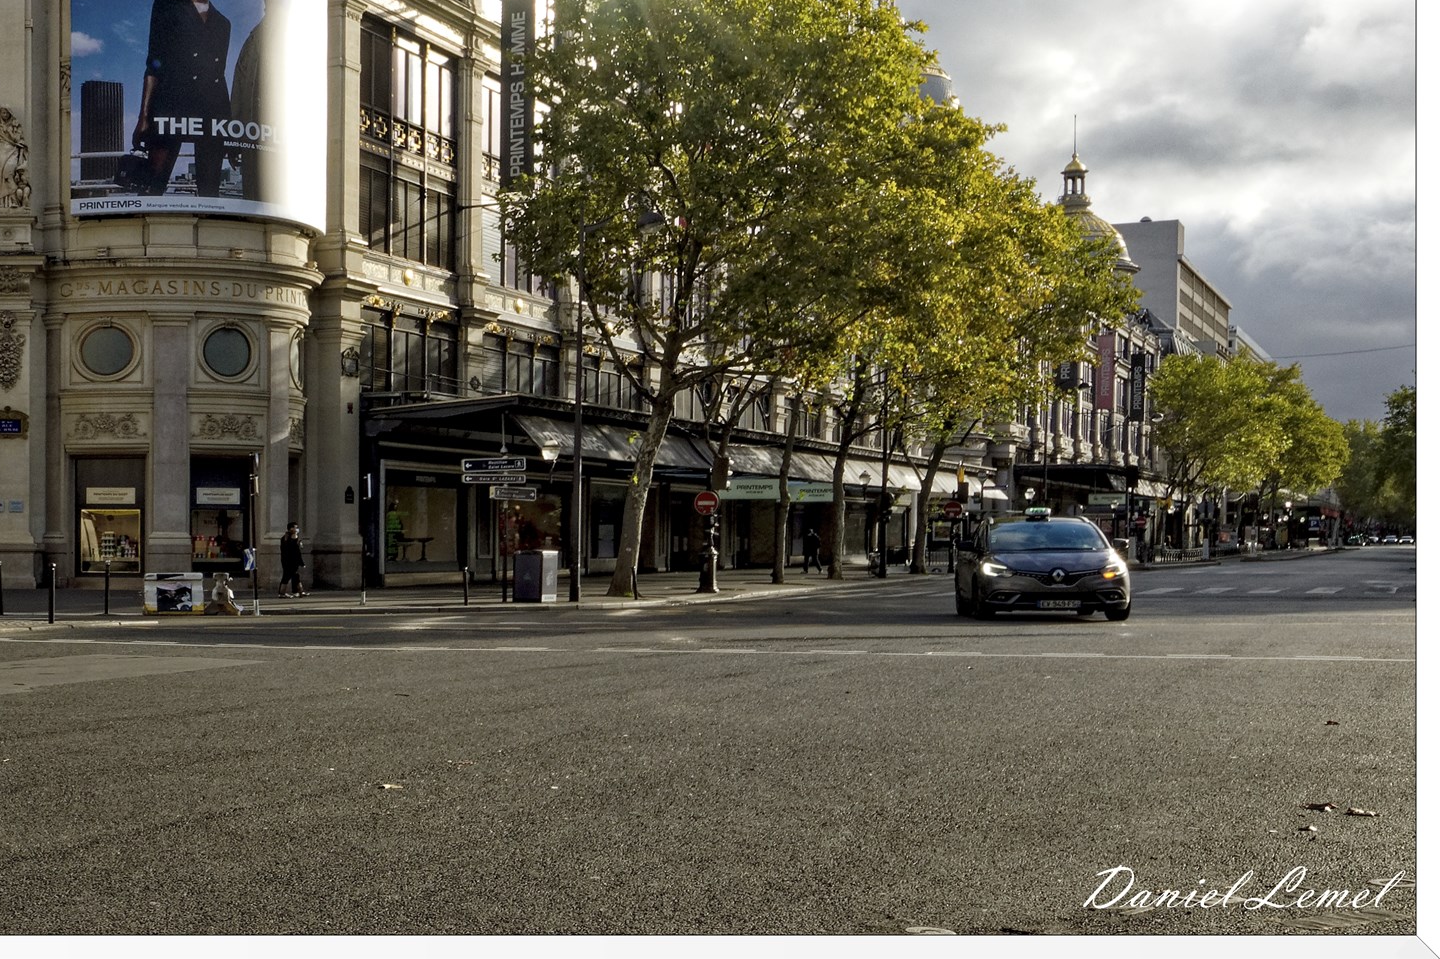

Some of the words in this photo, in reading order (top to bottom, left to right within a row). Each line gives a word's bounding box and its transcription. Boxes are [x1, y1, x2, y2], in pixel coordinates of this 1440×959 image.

[153, 117, 204, 136] THE
[510, 81, 525, 177] PRINTEMPS
[79, 199, 142, 211] PRINTEMPS
[97, 280, 221, 296] MAGASINS
[232, 283, 258, 299] DU
